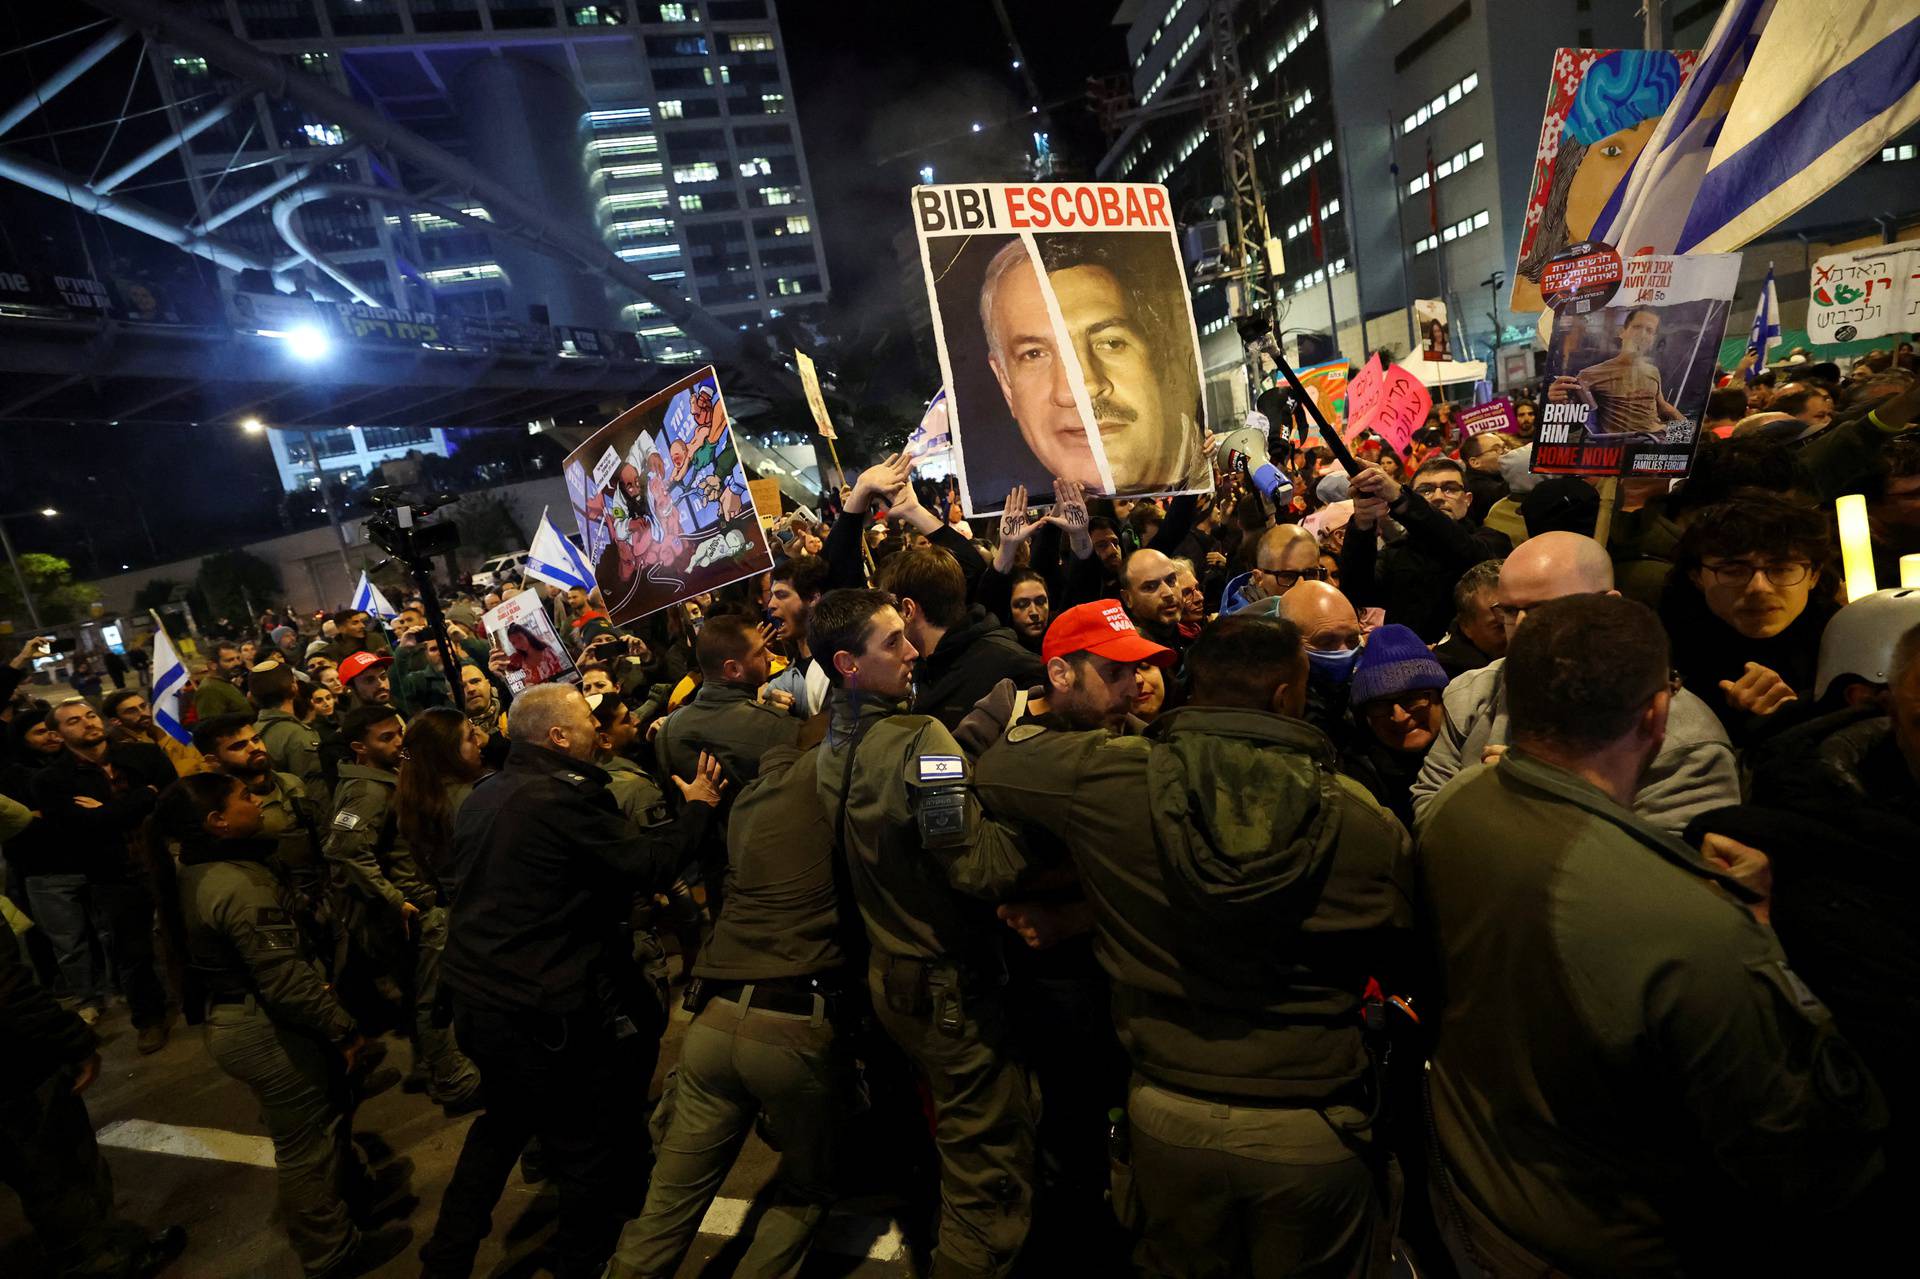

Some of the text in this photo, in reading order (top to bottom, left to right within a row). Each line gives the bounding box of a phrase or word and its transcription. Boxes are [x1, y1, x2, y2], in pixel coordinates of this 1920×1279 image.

[918, 187, 1170, 232] BIBI ESCOBAR
[1552, 254, 1612, 272] דורשים ועדת
[1651, 261, 1674, 274] אביב
[1544, 262, 1619, 282] חקירה ממלכתית
[1583, 269, 1619, 283] לאירועי
[1623, 274, 1672, 288] AVIV ATZILI
[1817, 304, 1882, 329] ולכיבוש
[1543, 403, 1590, 423] BRING
[1469, 417, 1505, 433] עכשיו
[1539, 424, 1569, 443] HIM
[1537, 446, 1620, 466] HOME NOW
[1632, 459, 1687, 470] FAMILIES FORUM
[1064, 509, 1088, 526] WAR
[1109, 619, 1136, 632] WA
[506, 669, 527, 684] BRING
